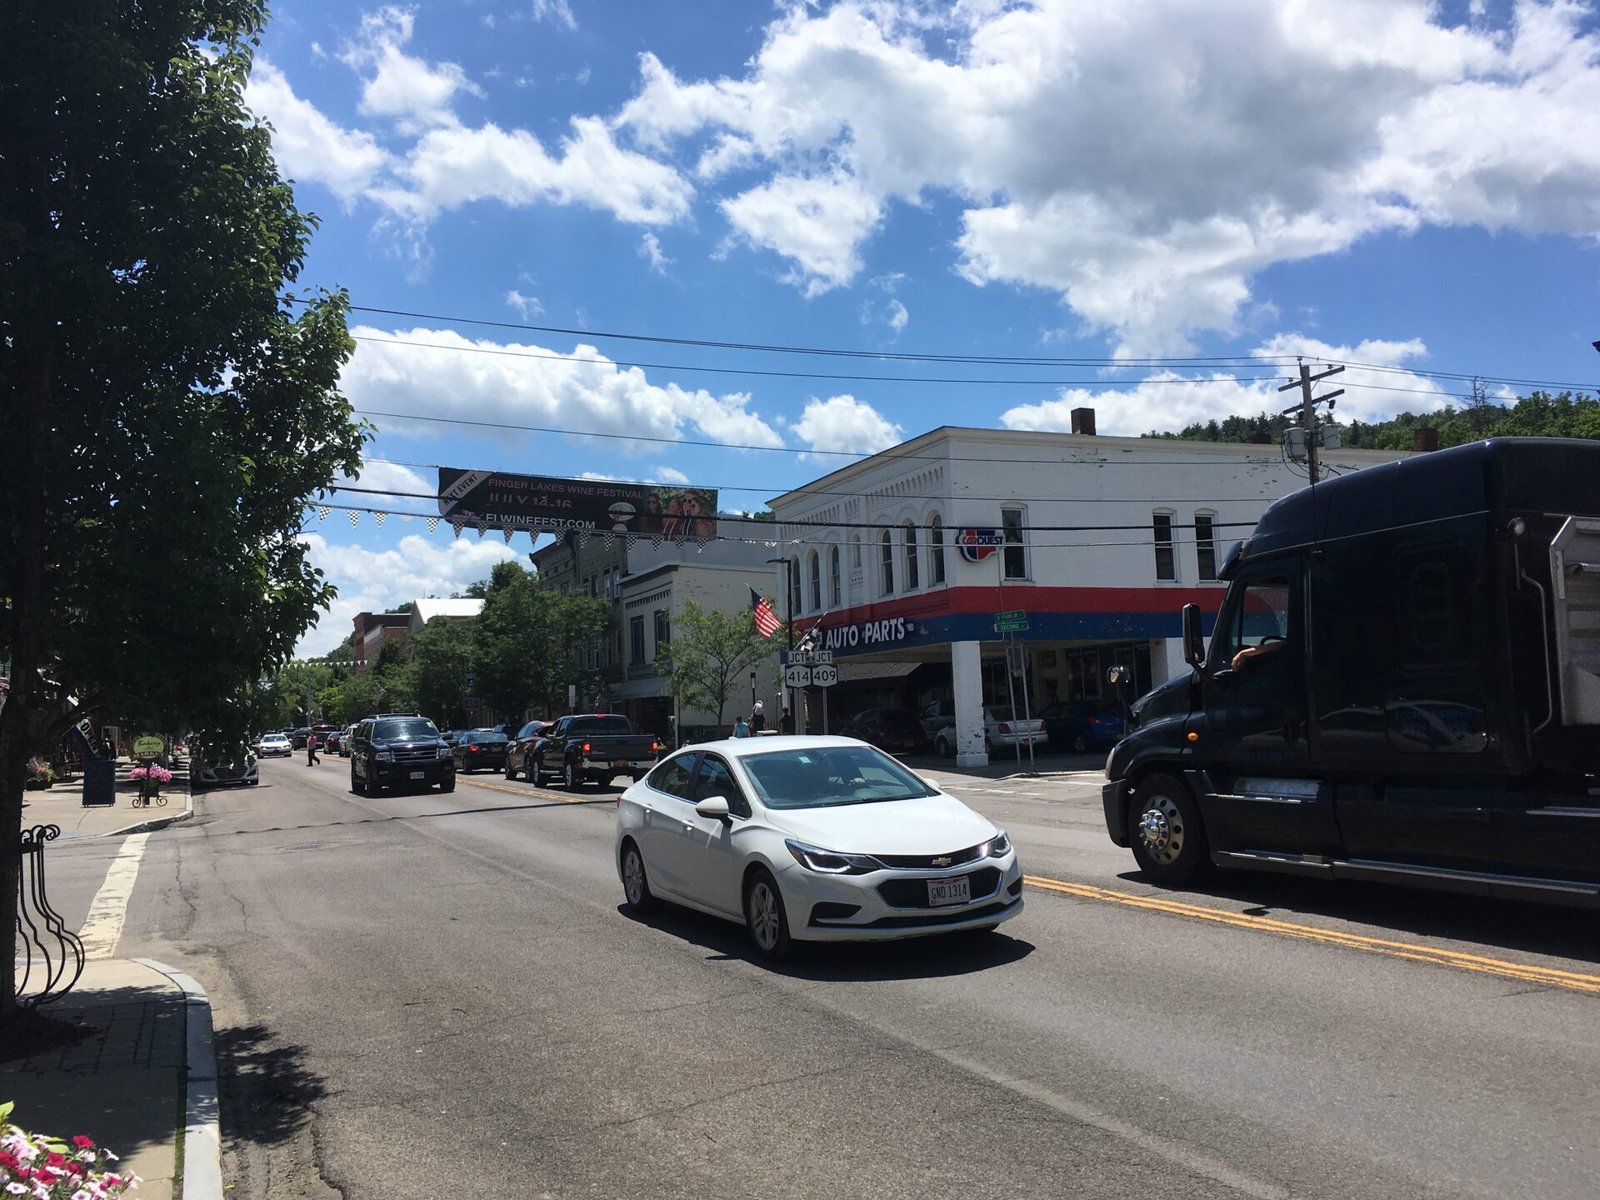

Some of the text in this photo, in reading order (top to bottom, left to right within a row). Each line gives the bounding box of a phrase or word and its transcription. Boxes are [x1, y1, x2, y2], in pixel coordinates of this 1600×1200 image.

[457, 473, 478, 493] EVENT
[488, 478, 643, 499] FINGER LAKES WINE FESTIVAL
[825, 617, 905, 649] AUTO PARTS
[789, 652, 832, 663] JCT JCT
[788, 670, 836, 682] 414 409
[931, 883, 967, 899] GND 1314
